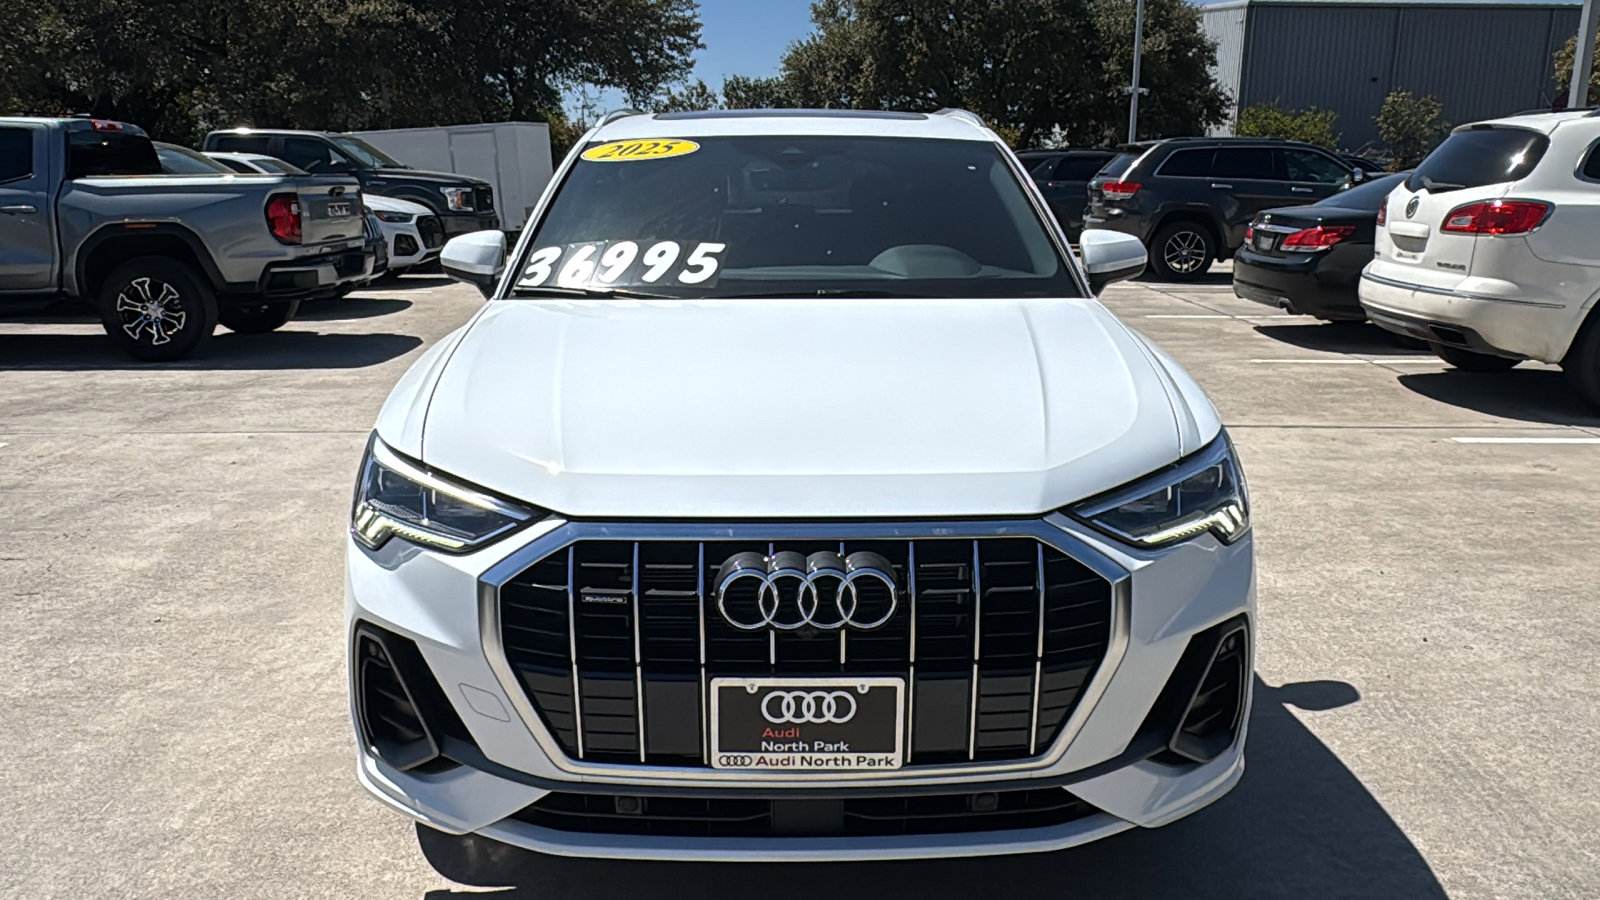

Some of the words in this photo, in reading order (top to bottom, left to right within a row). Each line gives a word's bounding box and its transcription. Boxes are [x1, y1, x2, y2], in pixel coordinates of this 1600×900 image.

[597, 141, 681, 159] 2025
[518, 240, 727, 288] 36995
[762, 726, 800, 738] Audi
[761, 740, 809, 752] North
[814, 740, 849, 752] Park
[755, 755, 796, 767] Audi
[800, 755, 850, 767] North
[856, 755, 895, 767] Park
